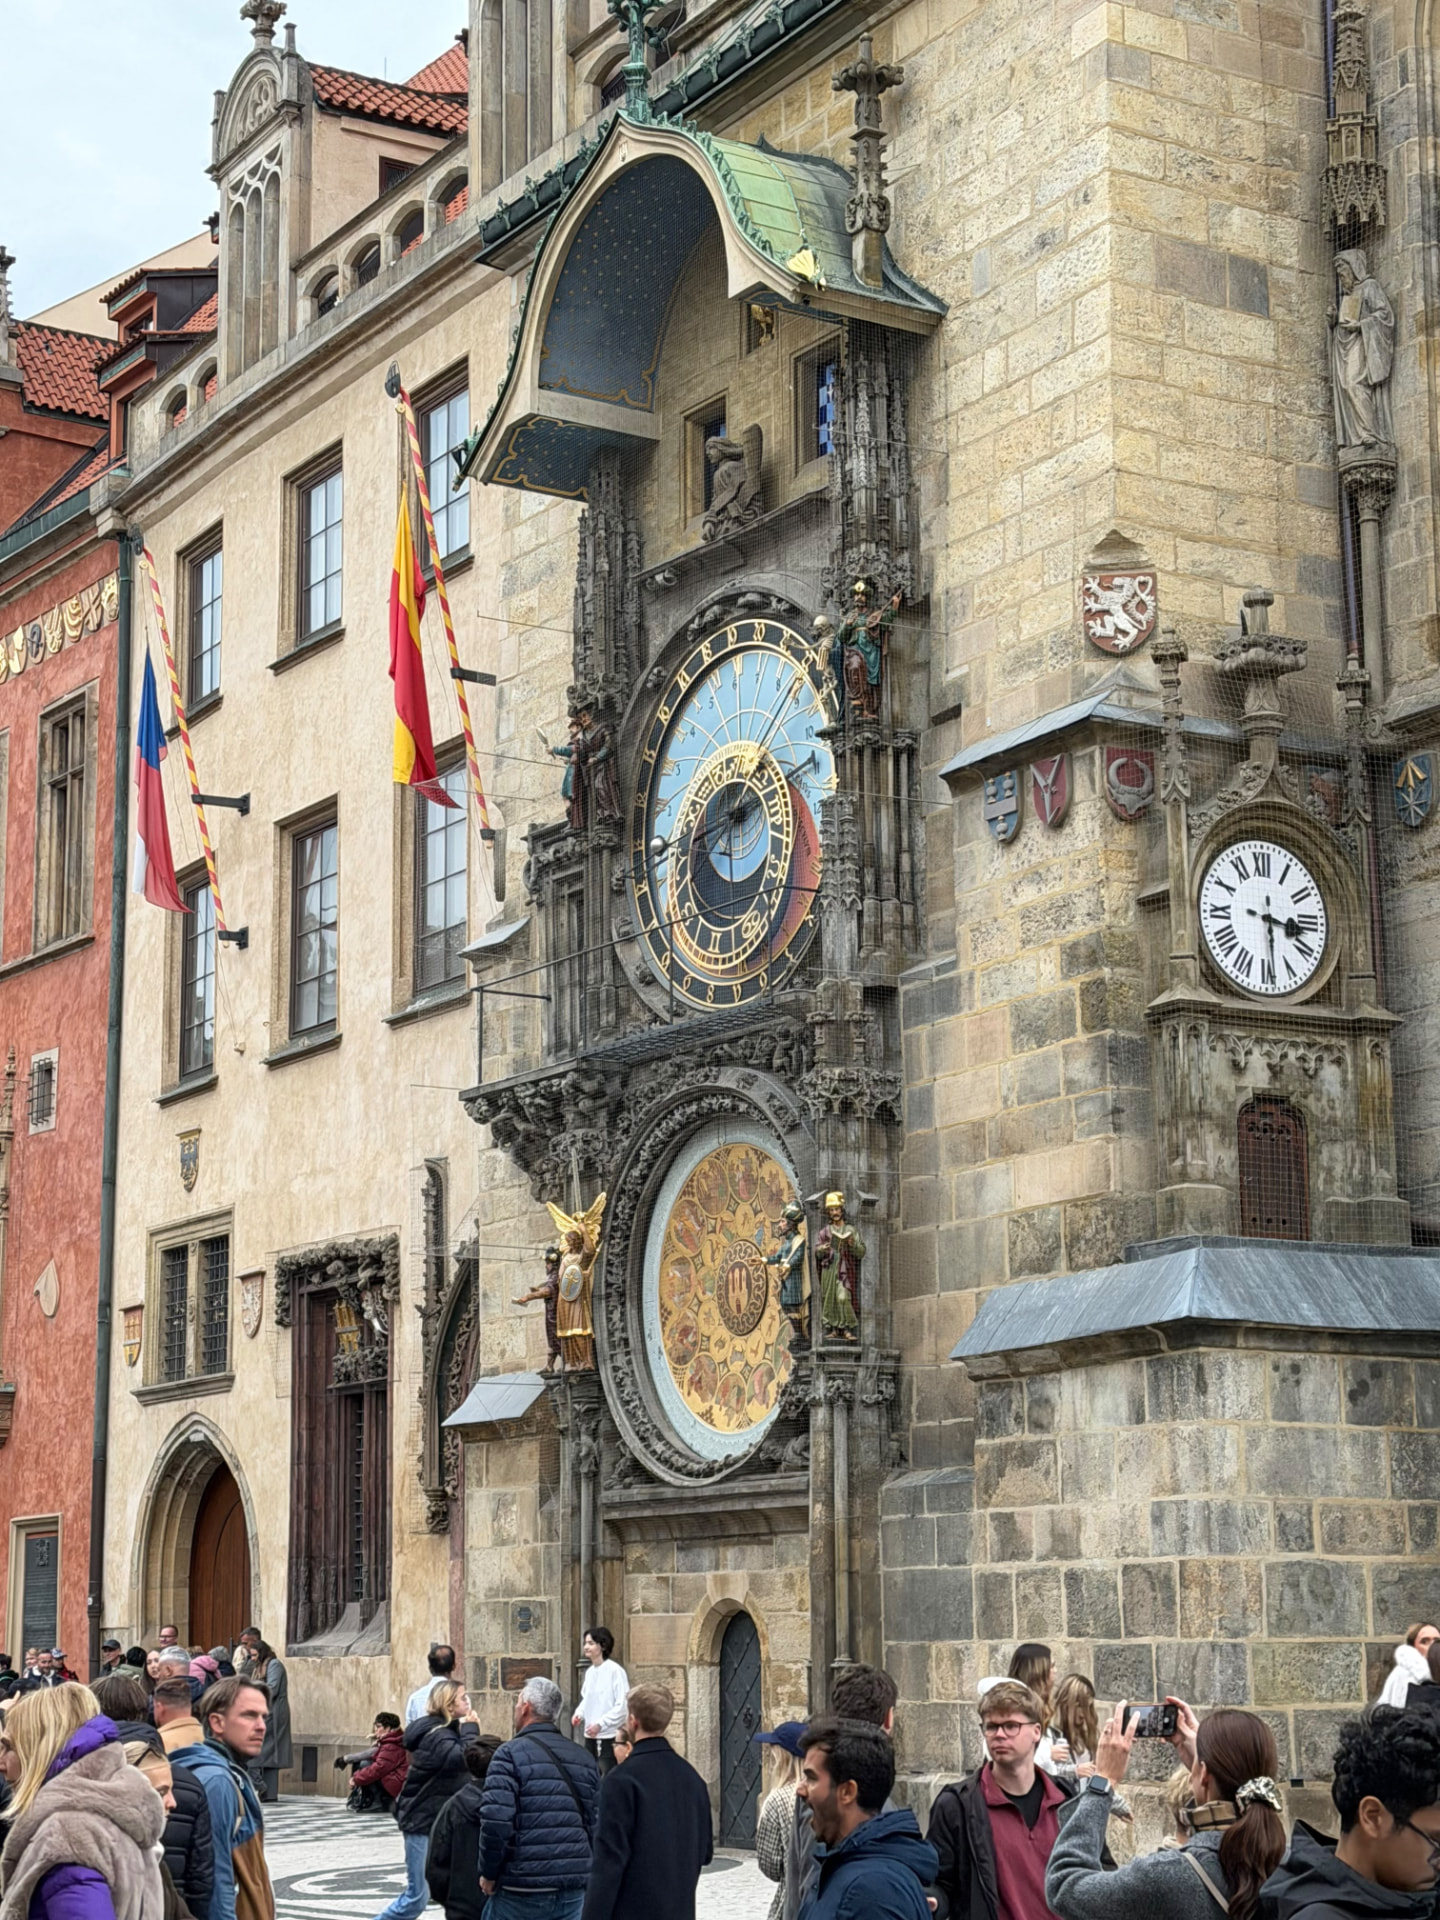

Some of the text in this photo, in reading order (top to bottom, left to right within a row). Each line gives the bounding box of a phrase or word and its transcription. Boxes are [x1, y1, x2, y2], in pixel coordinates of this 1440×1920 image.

[1229, 855, 1251, 885] XI
[1252, 851, 1271, 880] XII
[1278, 862, 1292, 886] I
[1214, 876, 1237, 898] X
[1290, 886, 1312, 905] II
[1209, 903, 1231, 920] IX
[1297, 914, 1319, 932] III
[1213, 924, 1240, 959] VIII
[1293, 937, 1314, 963] IV
[1232, 946, 1254, 979] VII
[1261, 958, 1277, 985] VI
[1282, 955, 1297, 981] V
